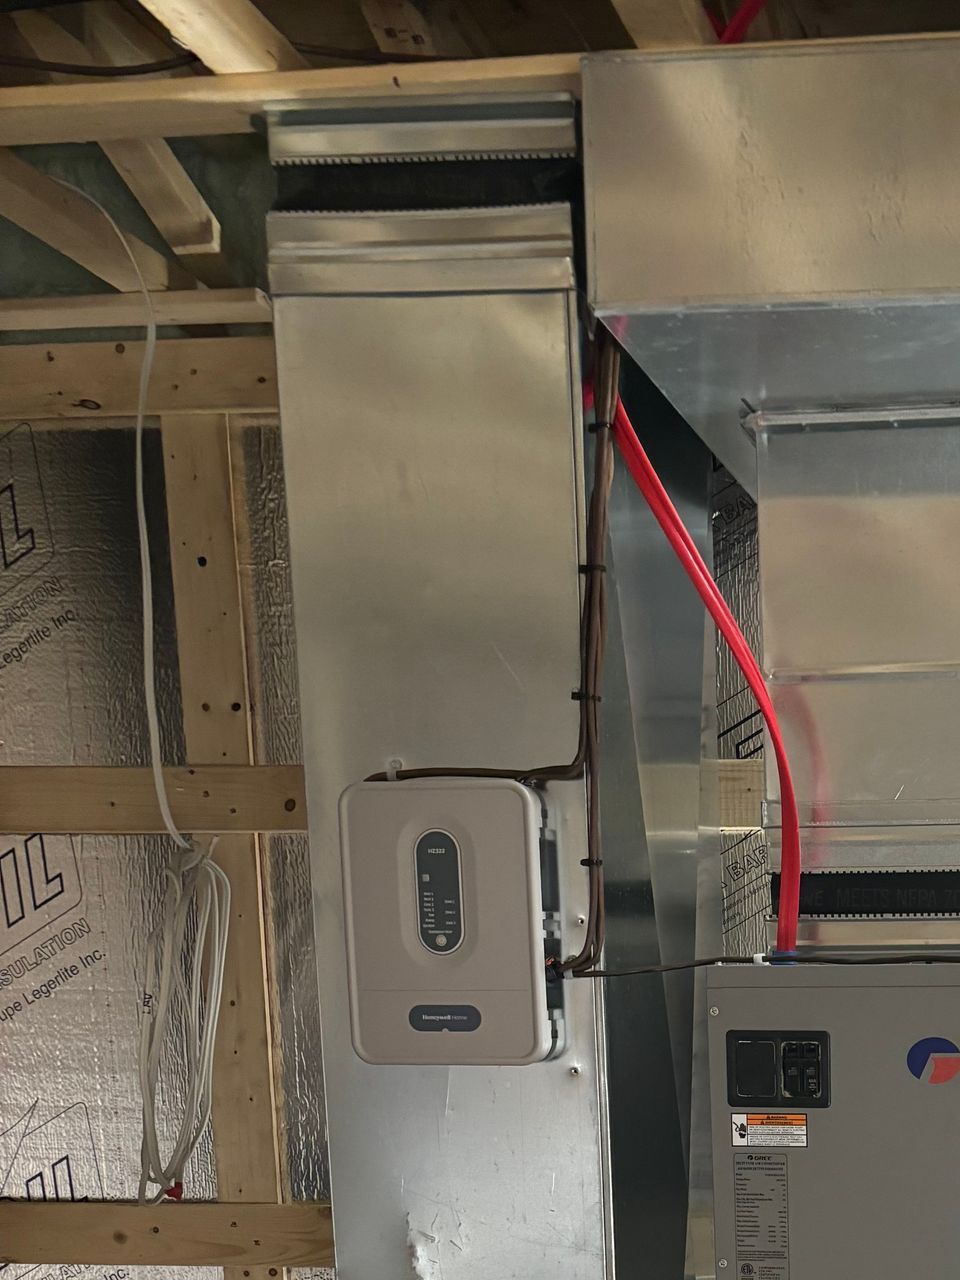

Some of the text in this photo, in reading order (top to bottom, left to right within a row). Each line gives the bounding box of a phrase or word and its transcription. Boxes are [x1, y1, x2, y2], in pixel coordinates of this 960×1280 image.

[837, 888, 889, 908] MEETS
[896, 888, 937, 907] NFPA
[0, 917, 91, 988] SULATION
[22, 964, 80, 1005] Legerlite
[79, 949, 106, 969] Inc.
